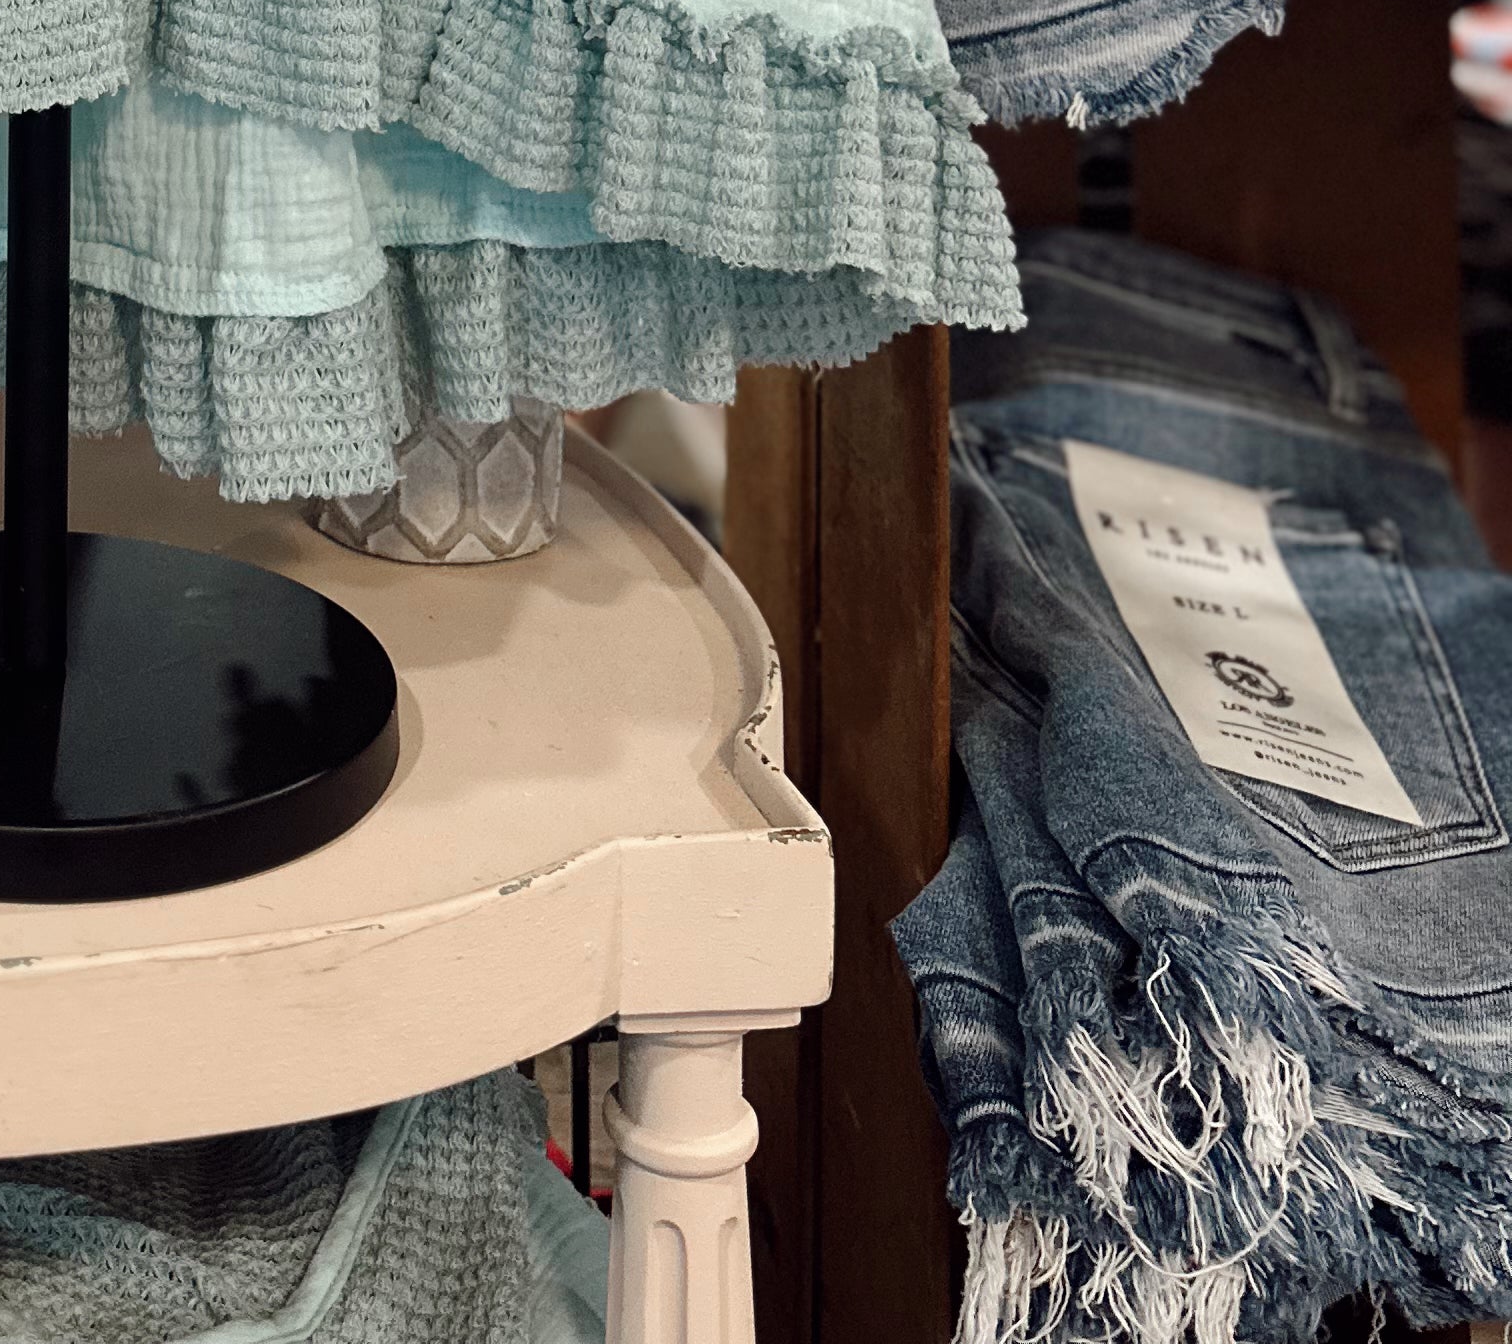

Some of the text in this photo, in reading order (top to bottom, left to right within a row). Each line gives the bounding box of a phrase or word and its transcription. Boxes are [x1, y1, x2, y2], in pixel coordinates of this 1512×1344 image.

[1097, 510, 1266, 566] RISEN
[1172, 595, 1250, 620] SIZE L
